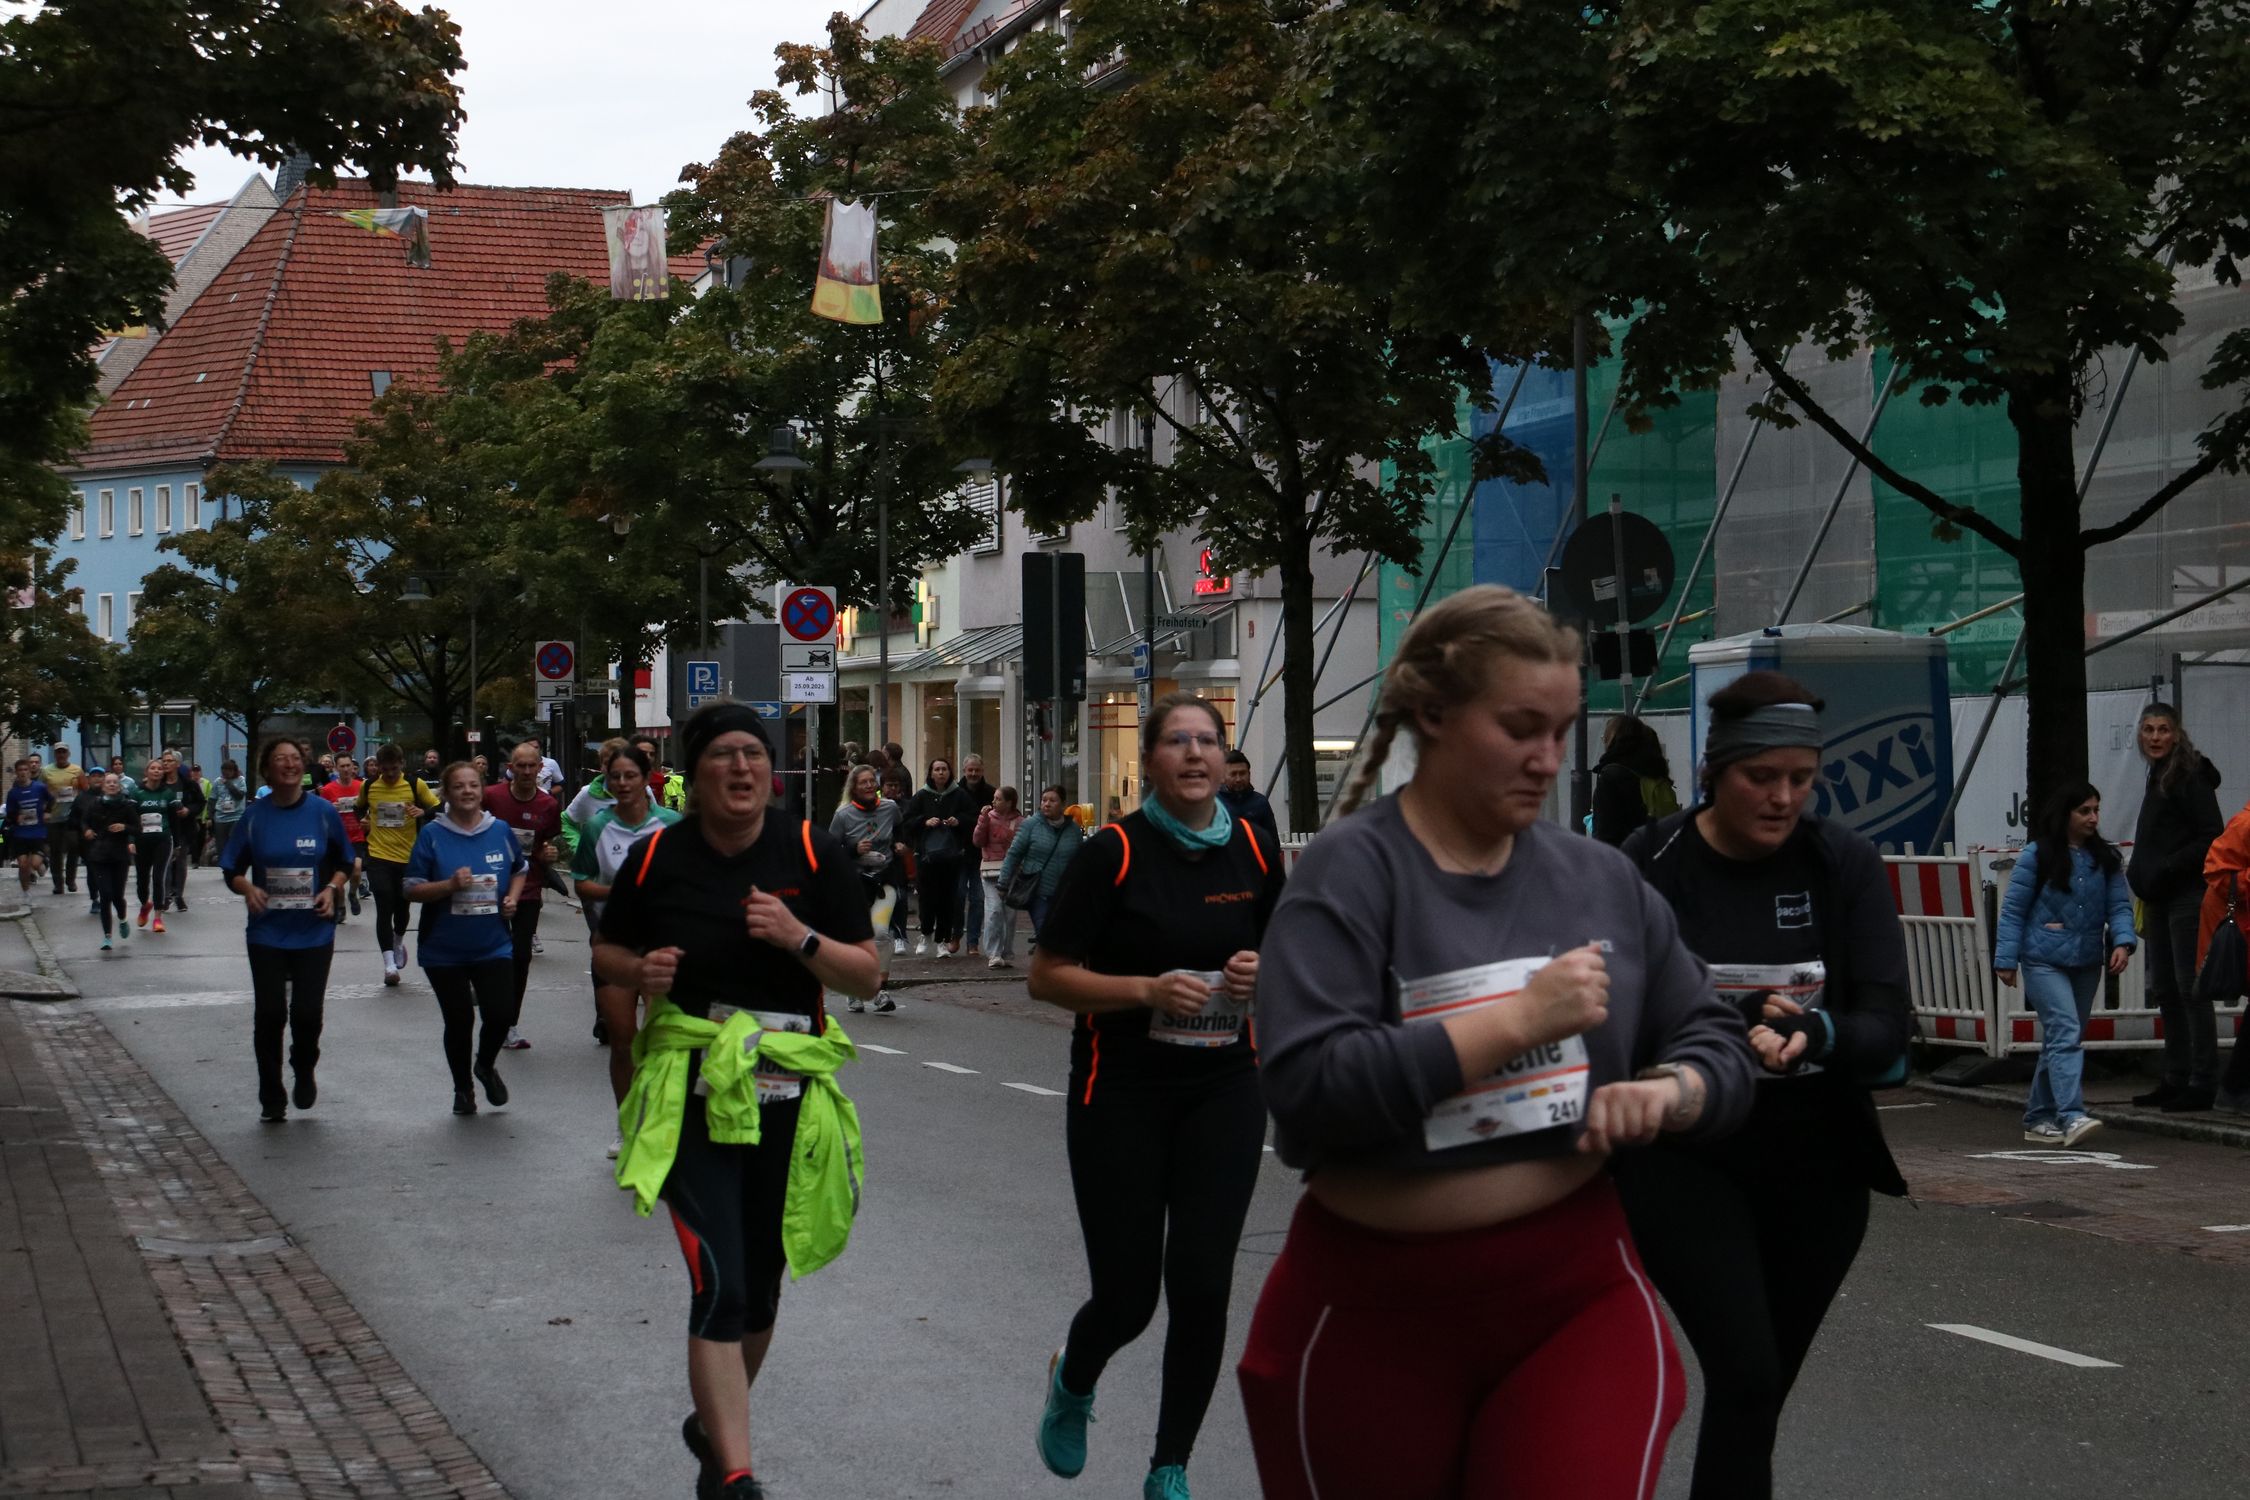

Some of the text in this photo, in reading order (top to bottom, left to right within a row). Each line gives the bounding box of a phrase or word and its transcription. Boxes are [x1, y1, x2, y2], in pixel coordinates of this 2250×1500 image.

[1157, 615, 1202, 629] Freihofstr.
[695, 666, 712, 691] P
[296, 838, 317, 848] DAA
[485, 853, 505, 864] DAA
[1548, 1100, 1579, 1122] 241
